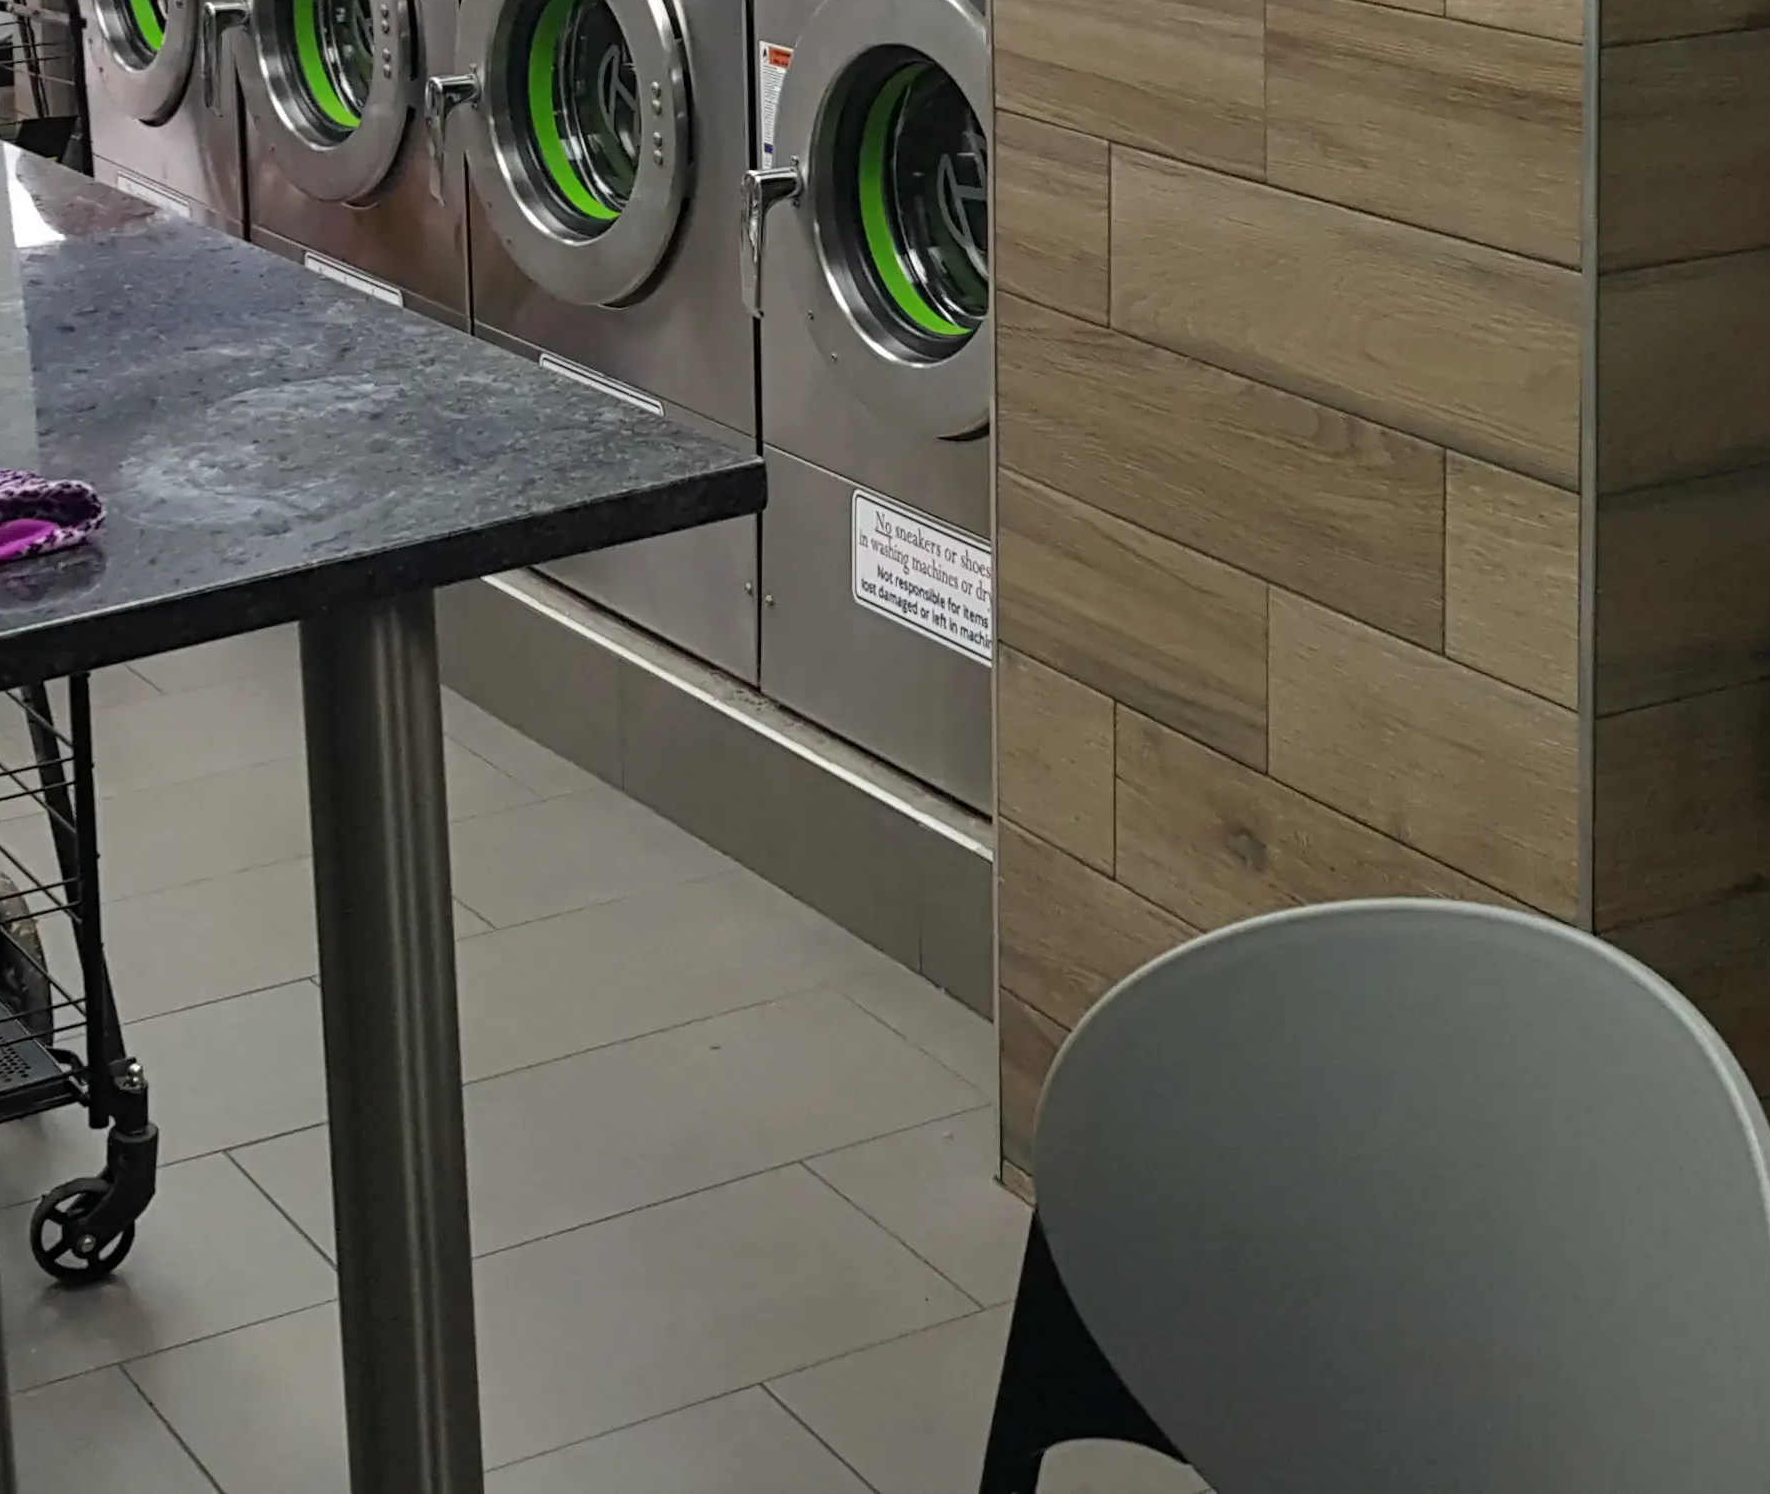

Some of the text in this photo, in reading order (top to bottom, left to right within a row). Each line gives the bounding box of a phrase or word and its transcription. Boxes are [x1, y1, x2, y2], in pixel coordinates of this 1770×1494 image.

[859, 528, 869, 548] in
[871, 537, 910, 575] washing
[911, 556, 959, 590] machines
[961, 583, 974, 597] or
[875, 510, 992, 579] No sneakers or shoes
[861, 577, 877, 596] lost
[878, 586, 918, 615] damaged
[920, 609, 930, 619] or
[932, 610, 947, 630] left
[949, 619, 958, 634] in
[876, 564, 989, 629] Not responsible for items
